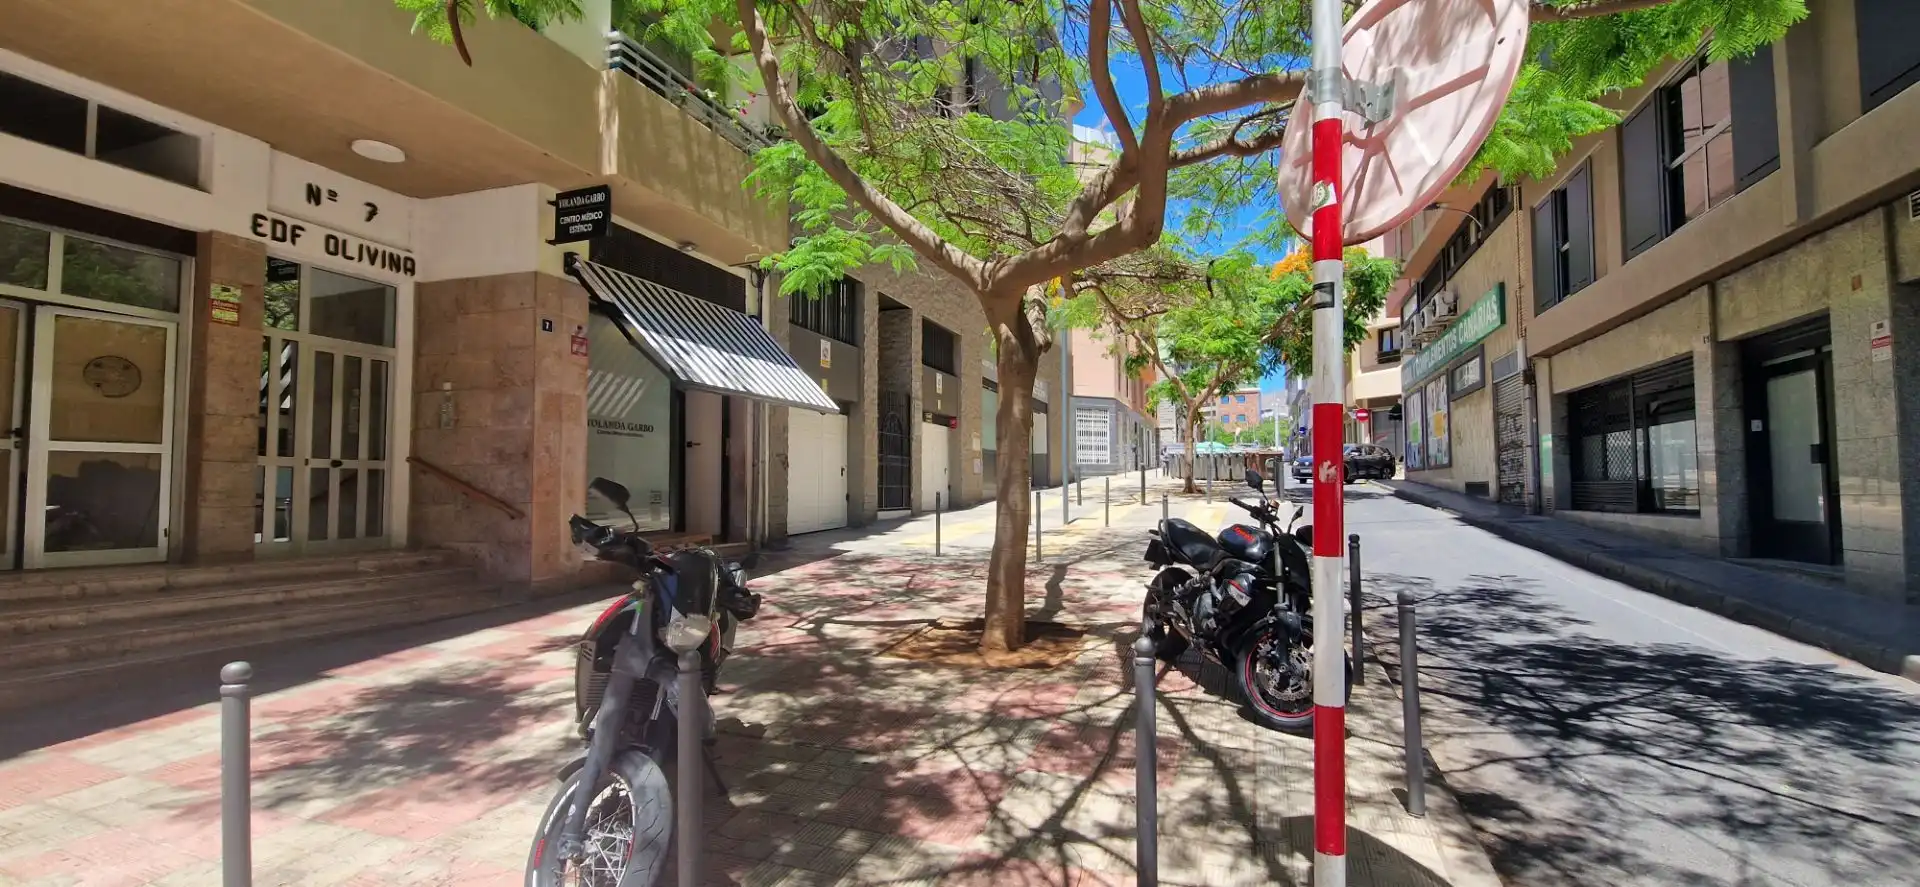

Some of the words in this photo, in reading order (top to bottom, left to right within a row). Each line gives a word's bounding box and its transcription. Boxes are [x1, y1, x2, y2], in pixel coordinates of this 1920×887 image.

[585, 192, 605, 204] GARBO
[364, 202, 379, 222] 7
[560, 215, 580, 224] CENTRO
[251, 213, 306, 246] EDF
[325, 234, 416, 277] OLIVINA
[1458, 295, 1498, 344] CANARIAS
[627, 423, 654, 432] GARBO
